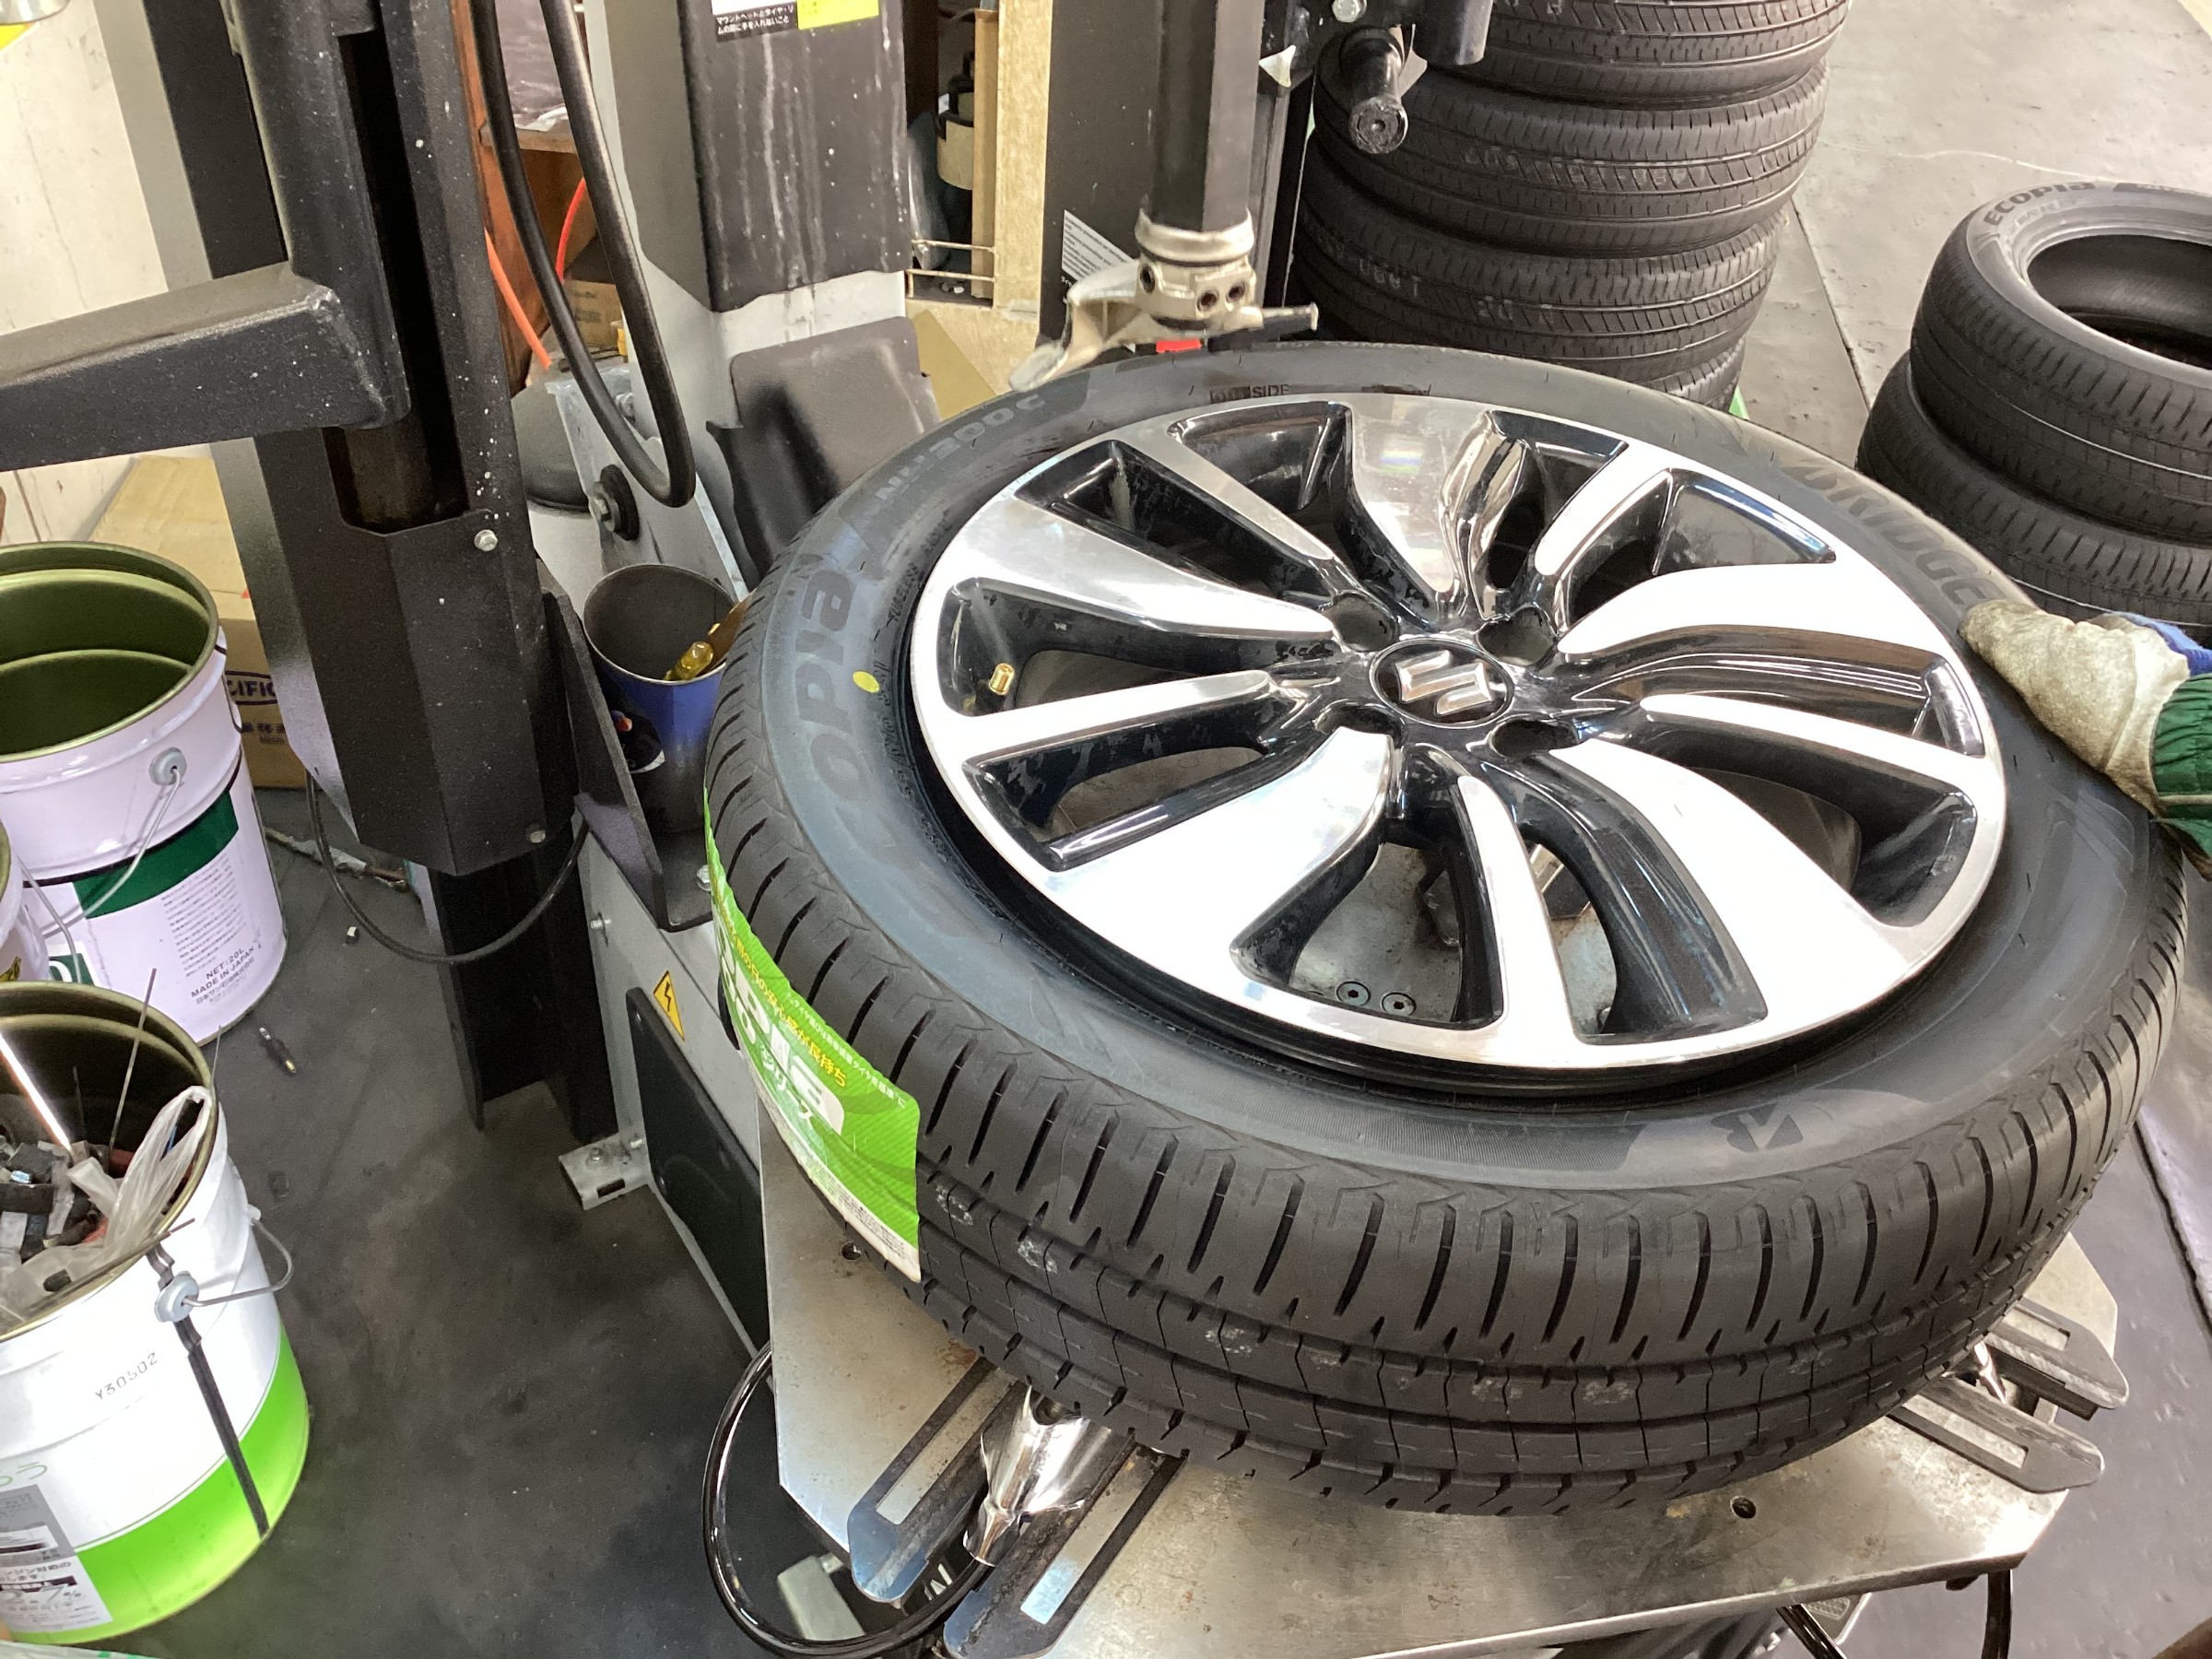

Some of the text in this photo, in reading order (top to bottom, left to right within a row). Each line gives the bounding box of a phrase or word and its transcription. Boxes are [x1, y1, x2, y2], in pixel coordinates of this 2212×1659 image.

[191, 977, 219, 998] MADE
[220, 968, 231, 980] IN
[230, 947, 255, 972] JAPAN
[95, 1351, 159, 1400] Y30502
